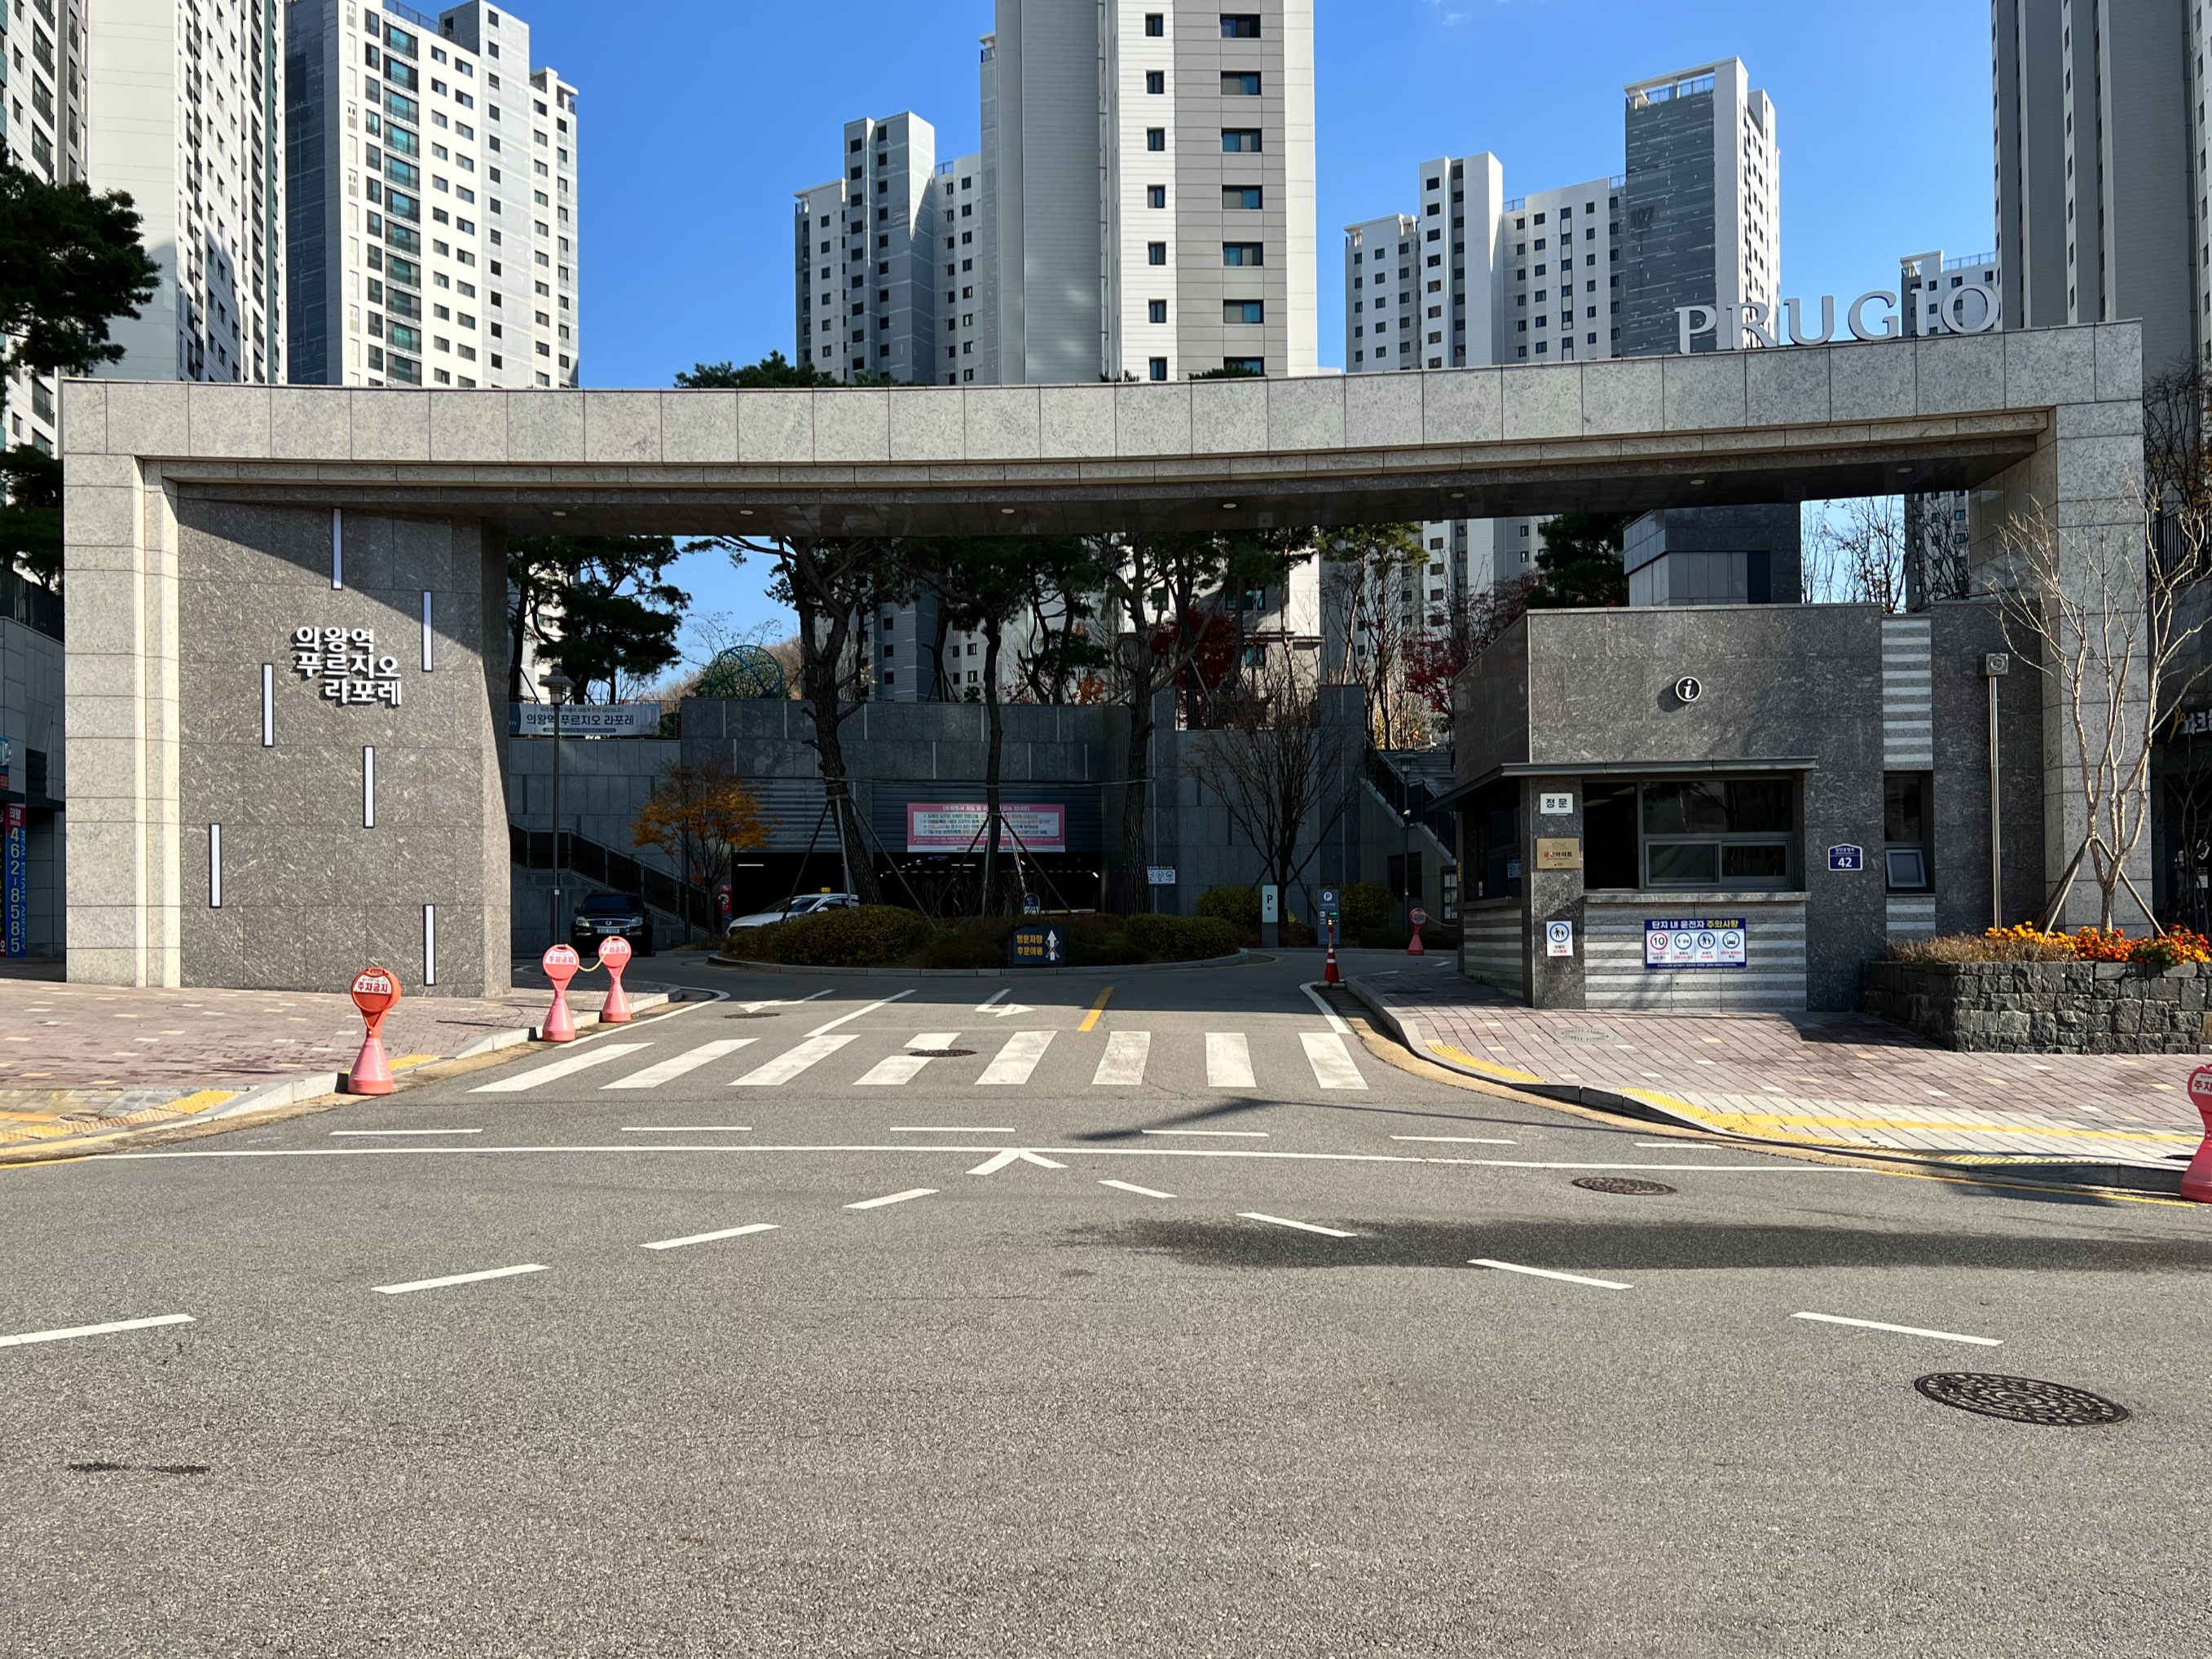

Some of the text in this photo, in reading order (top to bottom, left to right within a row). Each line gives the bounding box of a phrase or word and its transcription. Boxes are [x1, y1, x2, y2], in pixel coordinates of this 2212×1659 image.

[1674, 283, 2000, 354] PRUGIO
[295, 626, 374, 653] 의왕역
[296, 652, 402, 679] 푸르지오
[324, 679, 402, 706] 라포레
[561, 714, 601, 726] 푸르지오
[605, 714, 634, 726] 라포레
[1837, 856, 1853, 868] 42
[10, 827, 20, 953] 462-8585
[1267, 894, 1273, 904] P
[1651, 919, 1738, 929] 단지 내 운전자 주의사항
[1016, 934, 1043, 944] 방문차량
[1653, 936, 1665, 946] 10
[1017, 946, 1043, 956] 후문이용
[549, 956, 574, 964] 주차금지
[358, 981, 389, 993] 주차금지
